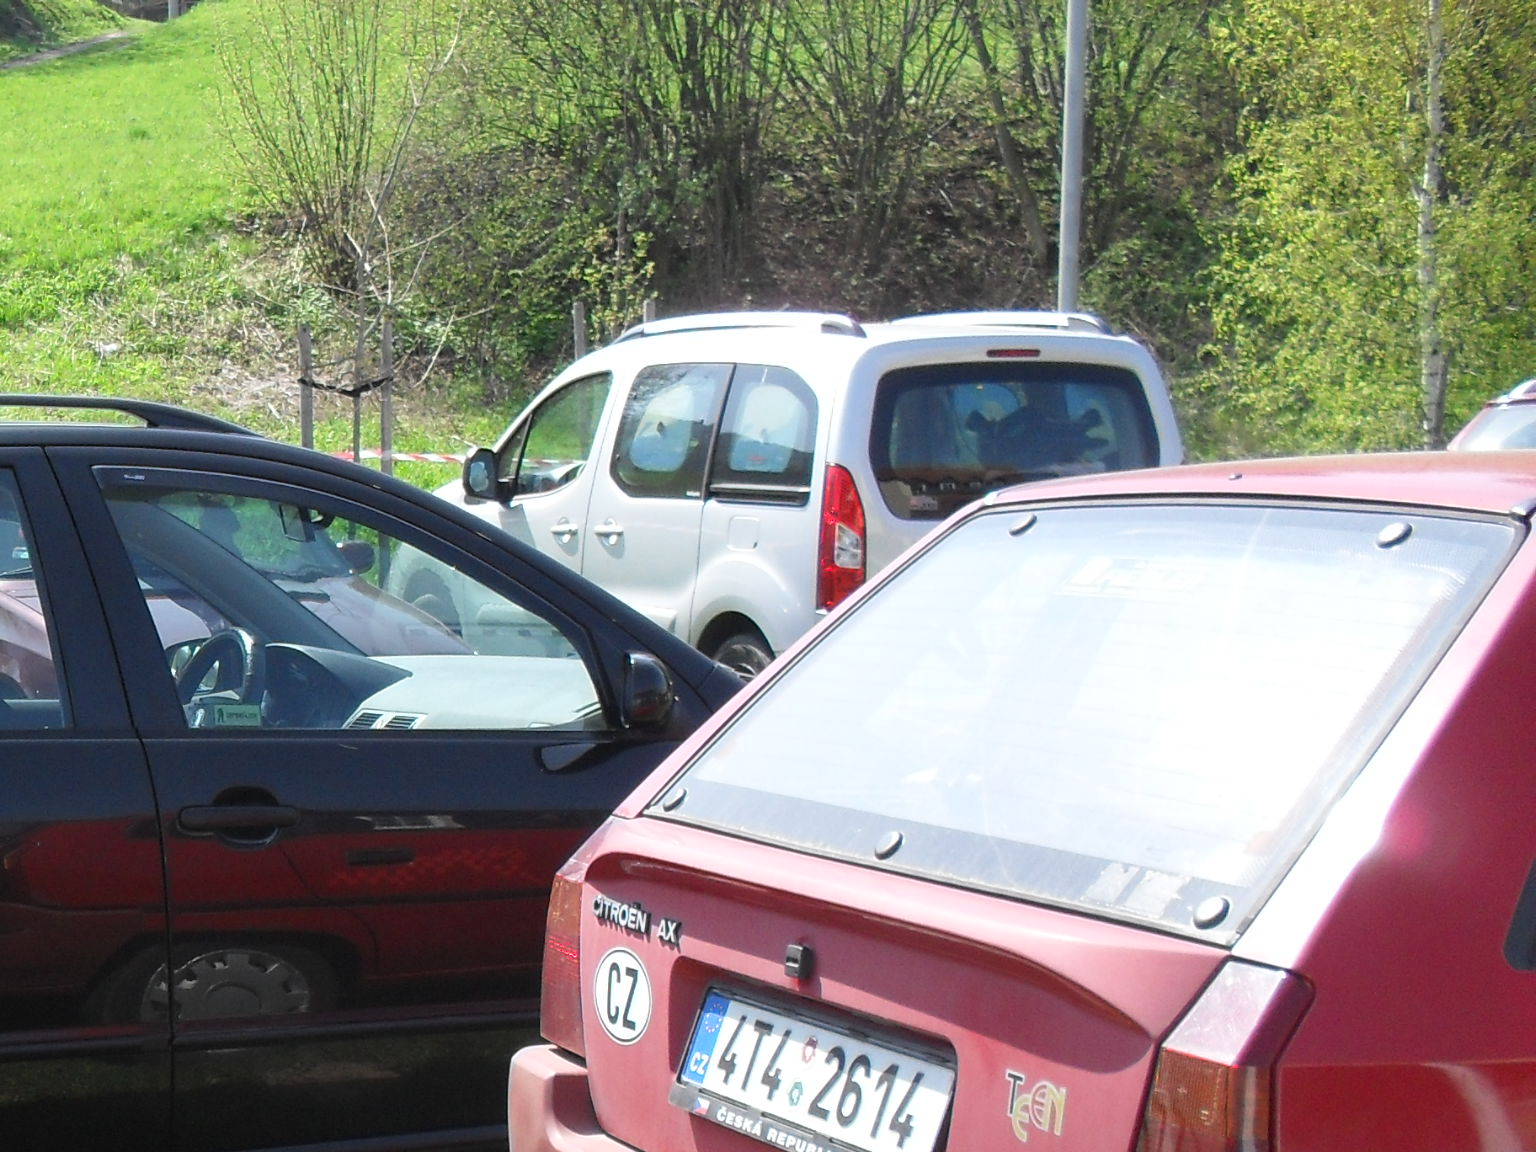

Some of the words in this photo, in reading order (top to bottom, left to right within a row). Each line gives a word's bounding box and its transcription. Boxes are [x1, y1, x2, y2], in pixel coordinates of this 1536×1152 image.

[657, 918, 680, 944] AX
[607, 961, 639, 1032] CZ
[689, 1051, 710, 1075] CZ
[717, 1015, 792, 1101] 4T4
[807, 1045, 925, 1150] 2614
[715, 1105, 763, 1138] ČESKÁ
